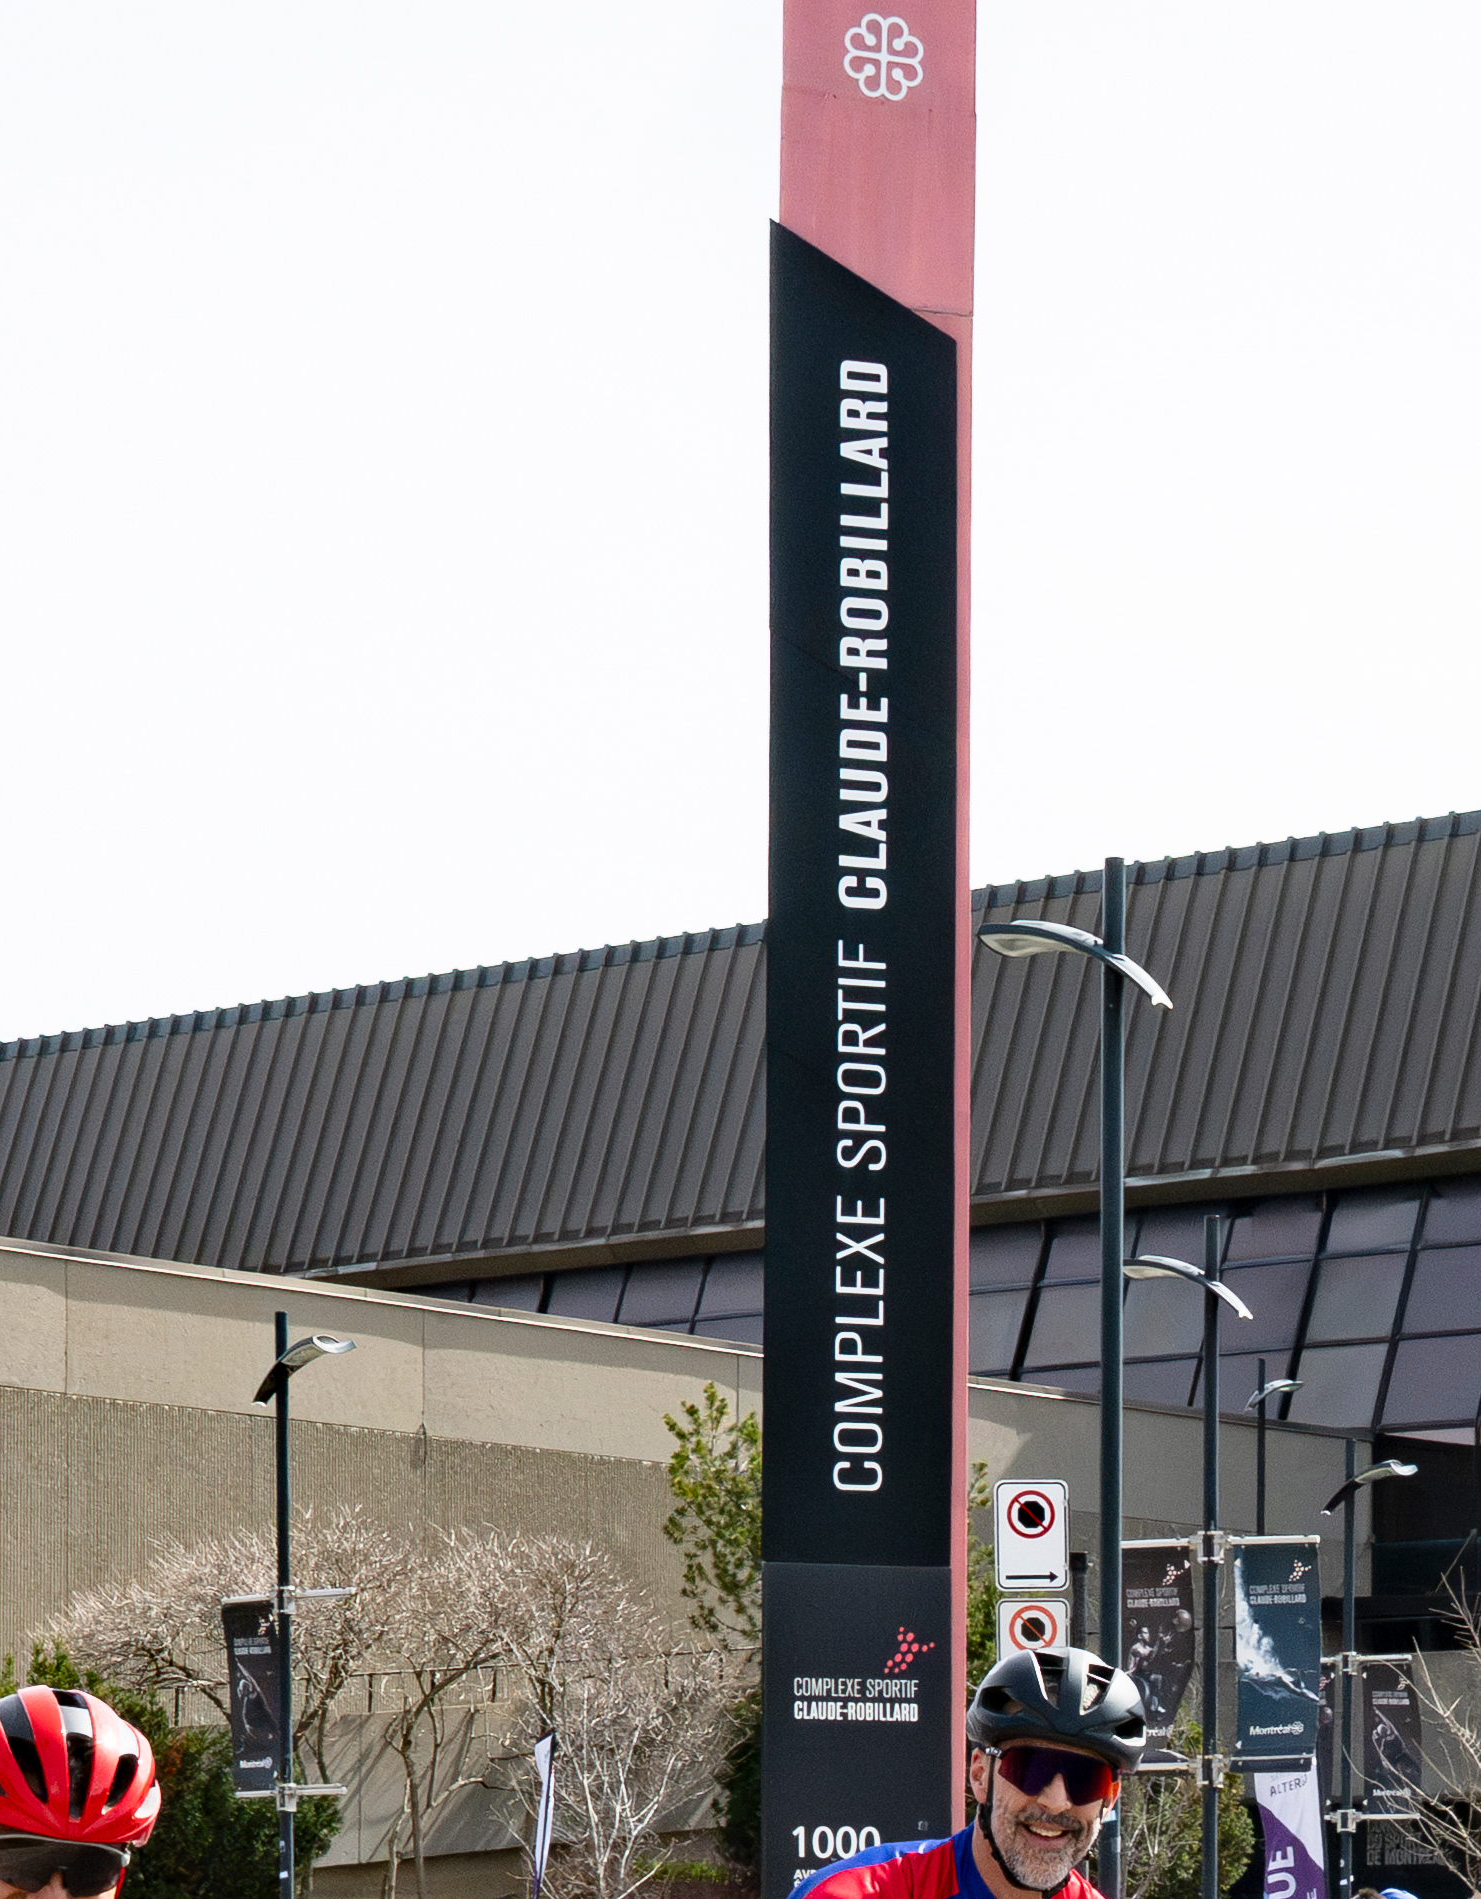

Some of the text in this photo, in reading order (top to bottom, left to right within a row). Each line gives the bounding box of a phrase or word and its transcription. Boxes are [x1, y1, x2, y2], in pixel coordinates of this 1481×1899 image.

[833, 360, 890, 1492] COMPLEXE SPORTIF CLAUDE-ROBILLARD
[793, 1677, 919, 1699] COMPLEXE SPORTIF
[793, 1701, 919, 1722] CLAUDE-ROBILLARD
[791, 1826, 882, 1860] 1000
